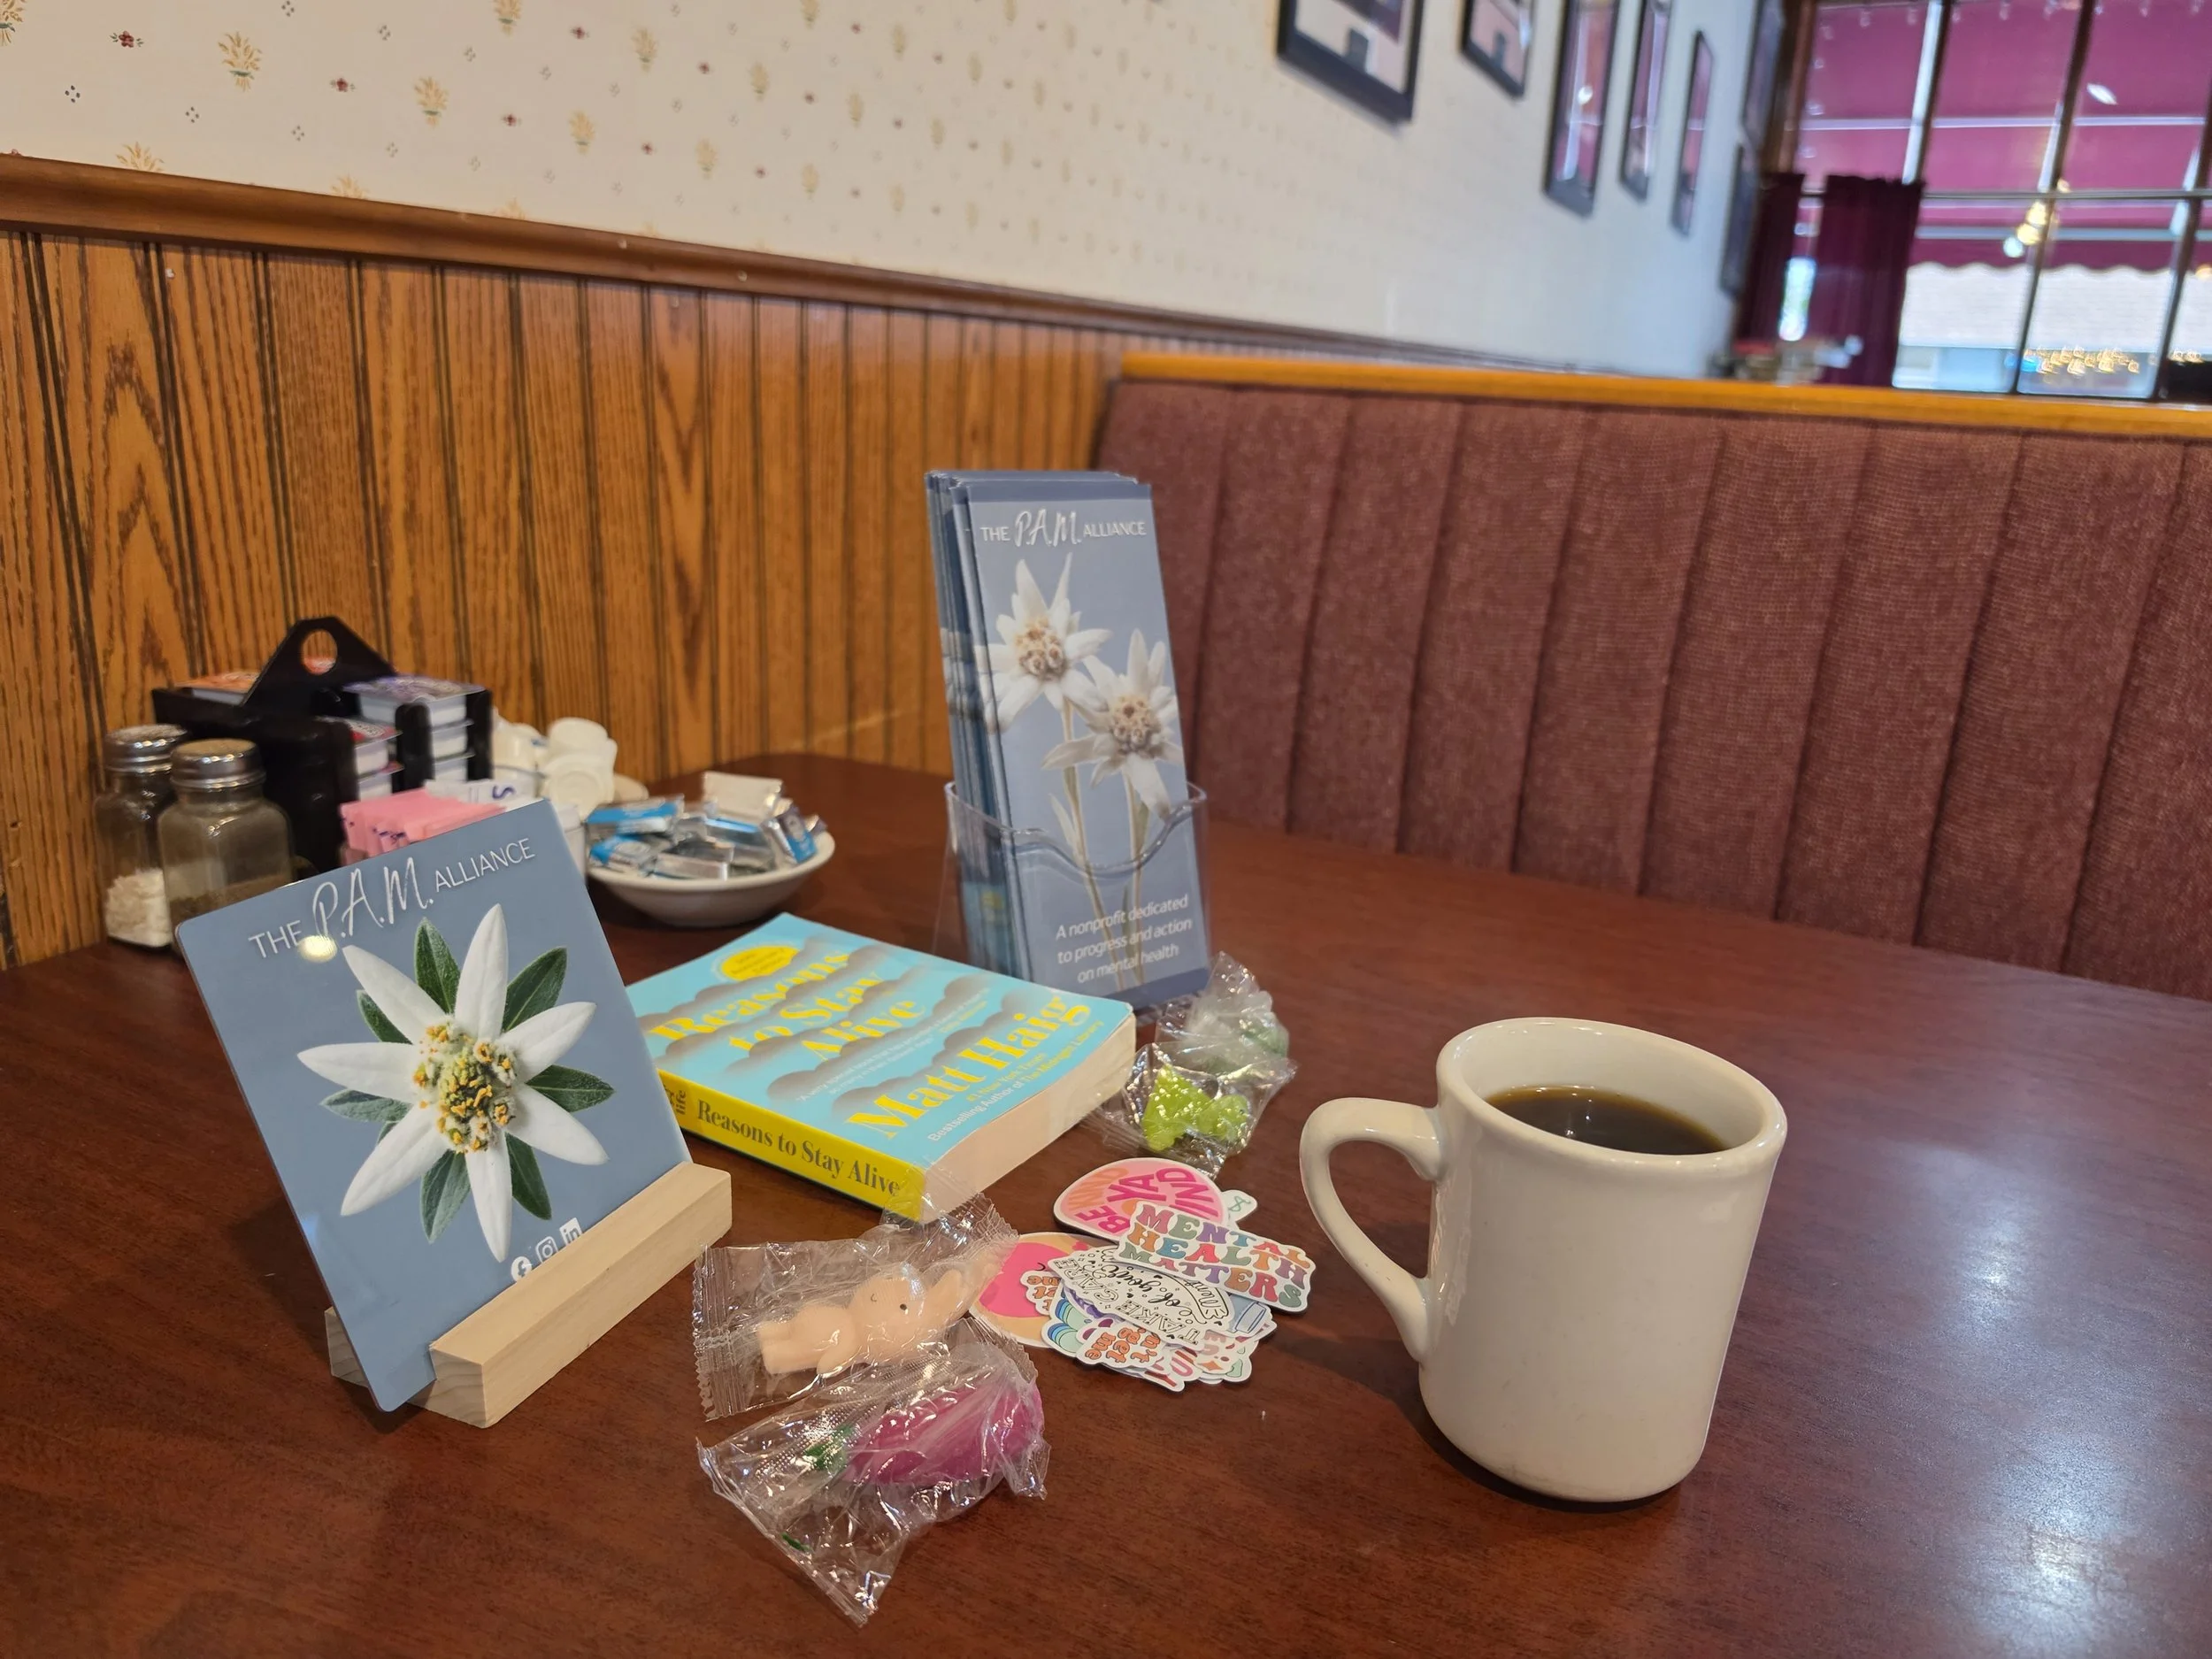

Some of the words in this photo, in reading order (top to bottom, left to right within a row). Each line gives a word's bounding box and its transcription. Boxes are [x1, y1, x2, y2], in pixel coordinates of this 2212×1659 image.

[980, 526, 1010, 541] THE
[1083, 521, 1147, 537] ALLIANCE
[248, 920, 303, 958] THE
[436, 838, 535, 893] ALLIANCE
[1056, 926, 1066, 941] A
[1069, 910, 1126, 937] nonprofit
[1128, 894, 1189, 921] dedicated
[1057, 951, 1072, 964] to
[1074, 935, 1127, 963] progress
[1129, 926, 1151, 944] and
[1154, 918, 1193, 938] action
[1077, 969, 1094, 983] on
[1096, 953, 1139, 978] mental
[1141, 943, 1180, 964] health
[648, 951, 849, 1040] Reasons
[729, 1025, 793, 1051] to
[780, 972, 887, 1026] Stay
[801, 1001, 925, 1061] Alive
[845, 1065, 986, 1140] Matt
[957, 995, 1091, 1070] Haig
[927, 1105, 987, 1141] Bestselling
[980, 1087, 1014, 1108] Author
[1012, 1080, 1025, 1089] of
[696, 1099, 773, 1148] Reasons
[778, 1133, 797, 1156] to
[801, 1139, 845, 1179] Stay
[847, 1160, 901, 1197] Alive
[1106, 1173, 1167, 1203] YA
[1074, 1205, 1131, 1234] BE
[1136, 1204, 1310, 1269] MENTAL
[1054, 1258, 1119, 1302] CARE
[1100, 1263, 1161, 1292] your
[1118, 1242, 1302, 1308] MATTERS
[1127, 1222, 1307, 1289] HEALTH
[1085, 1332, 1116, 1361] me
[1116, 1300, 1201, 1345] TAKE
